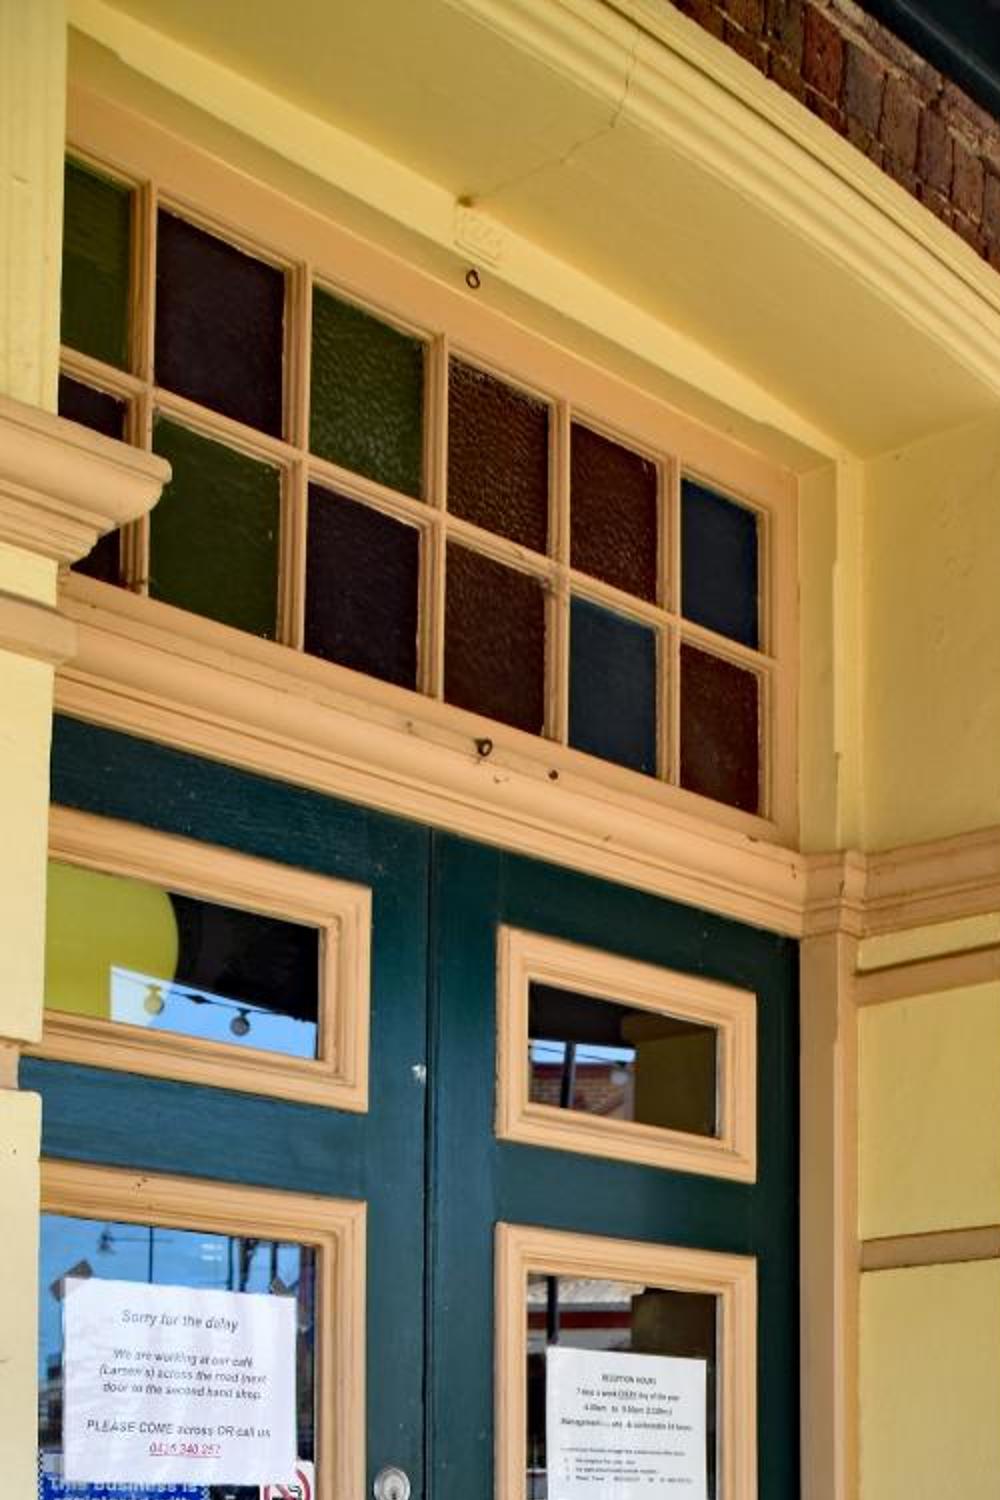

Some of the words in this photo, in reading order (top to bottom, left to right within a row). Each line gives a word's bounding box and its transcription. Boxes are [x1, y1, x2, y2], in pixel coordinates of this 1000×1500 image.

[121, 1309, 157, 1326] Sorry
[160, 1314, 179, 1326] for
[182, 1315, 201, 1327] the
[205, 1316, 238, 1333] delay
[195, 1370, 212, 1381] the
[87, 1419, 134, 1432] PLEASE
[139, 1421, 173, 1435] COME
[178, 1424, 212, 1437] across
[217, 1425, 234, 1437] OR
